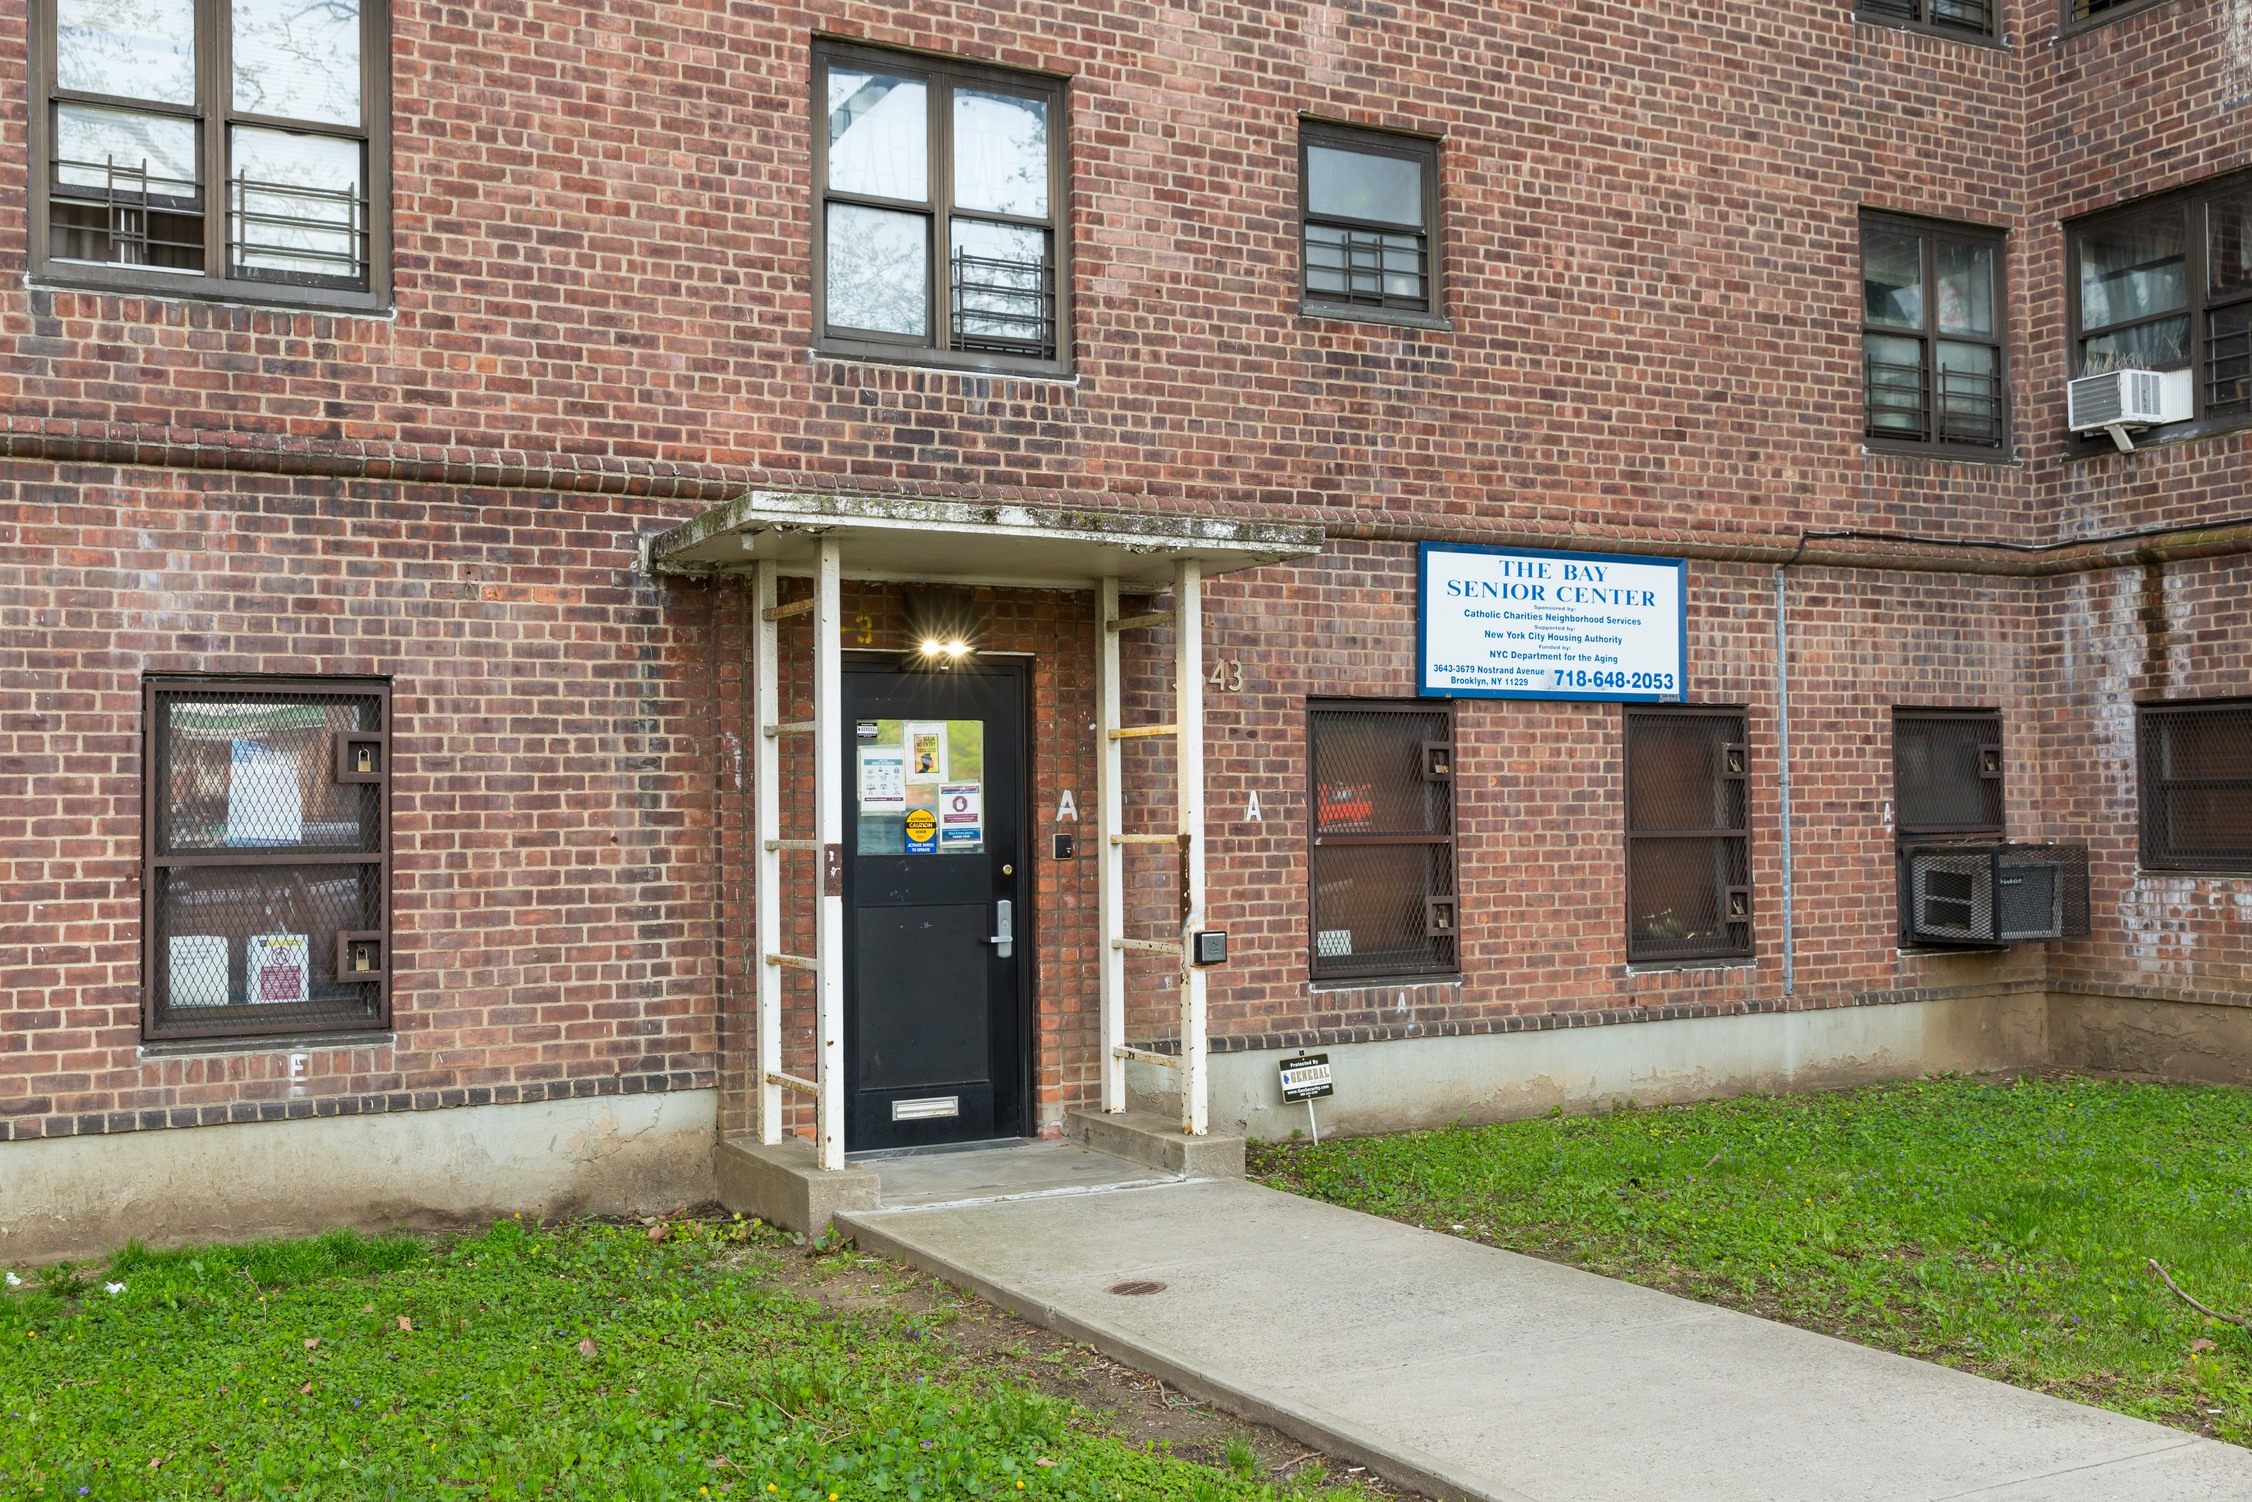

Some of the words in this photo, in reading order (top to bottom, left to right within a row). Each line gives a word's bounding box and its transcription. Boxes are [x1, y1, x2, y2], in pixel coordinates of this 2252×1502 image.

[1499, 560, 1552, 579] THE
[1564, 564, 1608, 582] BAY
[1447, 579, 1546, 601] SENIOR
[1556, 586, 1656, 607] CENTER
[1463, 609, 1501, 619] Catholic
[1503, 611, 1543, 621] Charities
[1545, 613, 1604, 624] Neighborhood
[1606, 616, 1642, 626] Services
[1484, 630, 1504, 639] New
[1506, 631, 1526, 640] York
[1528, 632, 1545, 642] City
[1547, 633, 1582, 644] Housing
[1584, 634, 1623, 645] Authority
[1489, 650, 1508, 659] NYC
[1511, 651, 1562, 661] Department
[1564, 653, 1576, 661] for
[1578, 654, 1592, 662] the
[1594, 654, 1618, 664] Aging
[1433, 664, 1475, 673] 3643-3679
[1477, 665, 1514, 675] Nostrand
[1516, 667, 1545, 675] Avenue
[1450, 676, 1489, 687] Brooklyn,
[1491, 677, 1503, 686] NY
[1505, 678, 1529, 686] 11229
[1554, 669, 1674, 690] 718-648-2053
[1056, 789, 1078, 822] A
[1245, 789, 1262, 822] A
[1290, 1067, 1330, 1083] GENERAL
